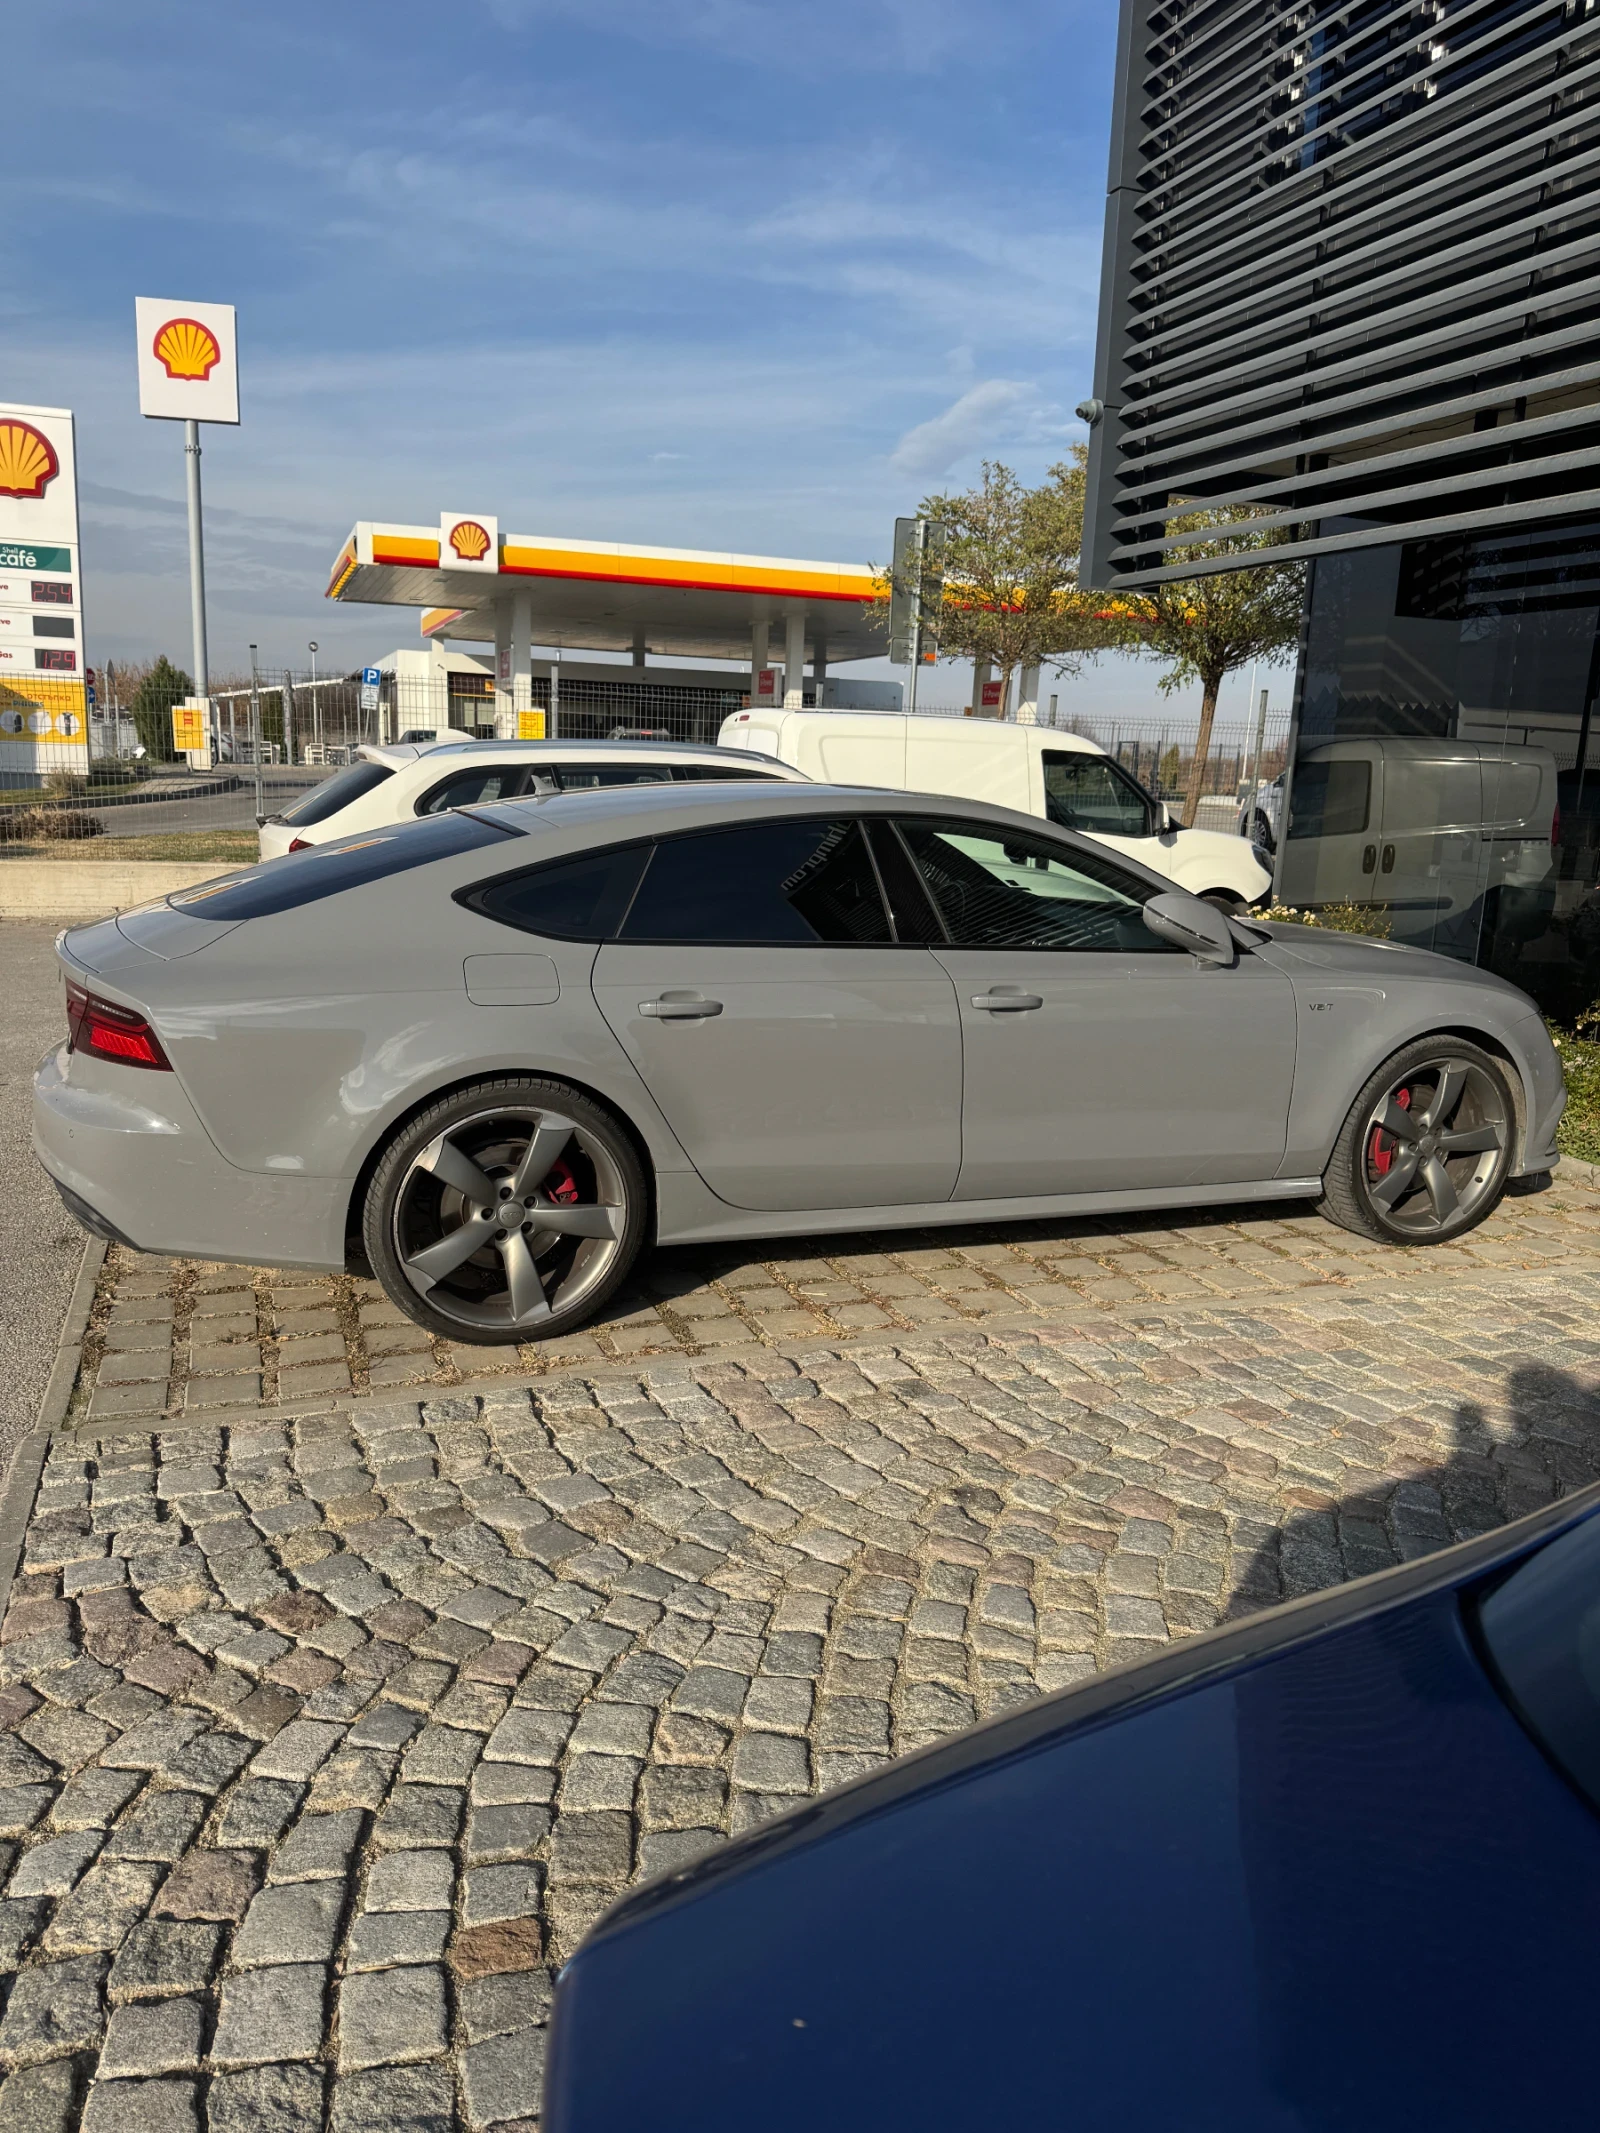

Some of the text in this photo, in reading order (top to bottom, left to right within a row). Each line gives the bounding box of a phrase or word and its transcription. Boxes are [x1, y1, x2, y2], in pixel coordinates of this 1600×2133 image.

[0, 550, 37, 568] café
[32, 582, 72, 603] 2.54
[43, 651, 75, 670] 1.29
[367, 669, 377, 682] P
